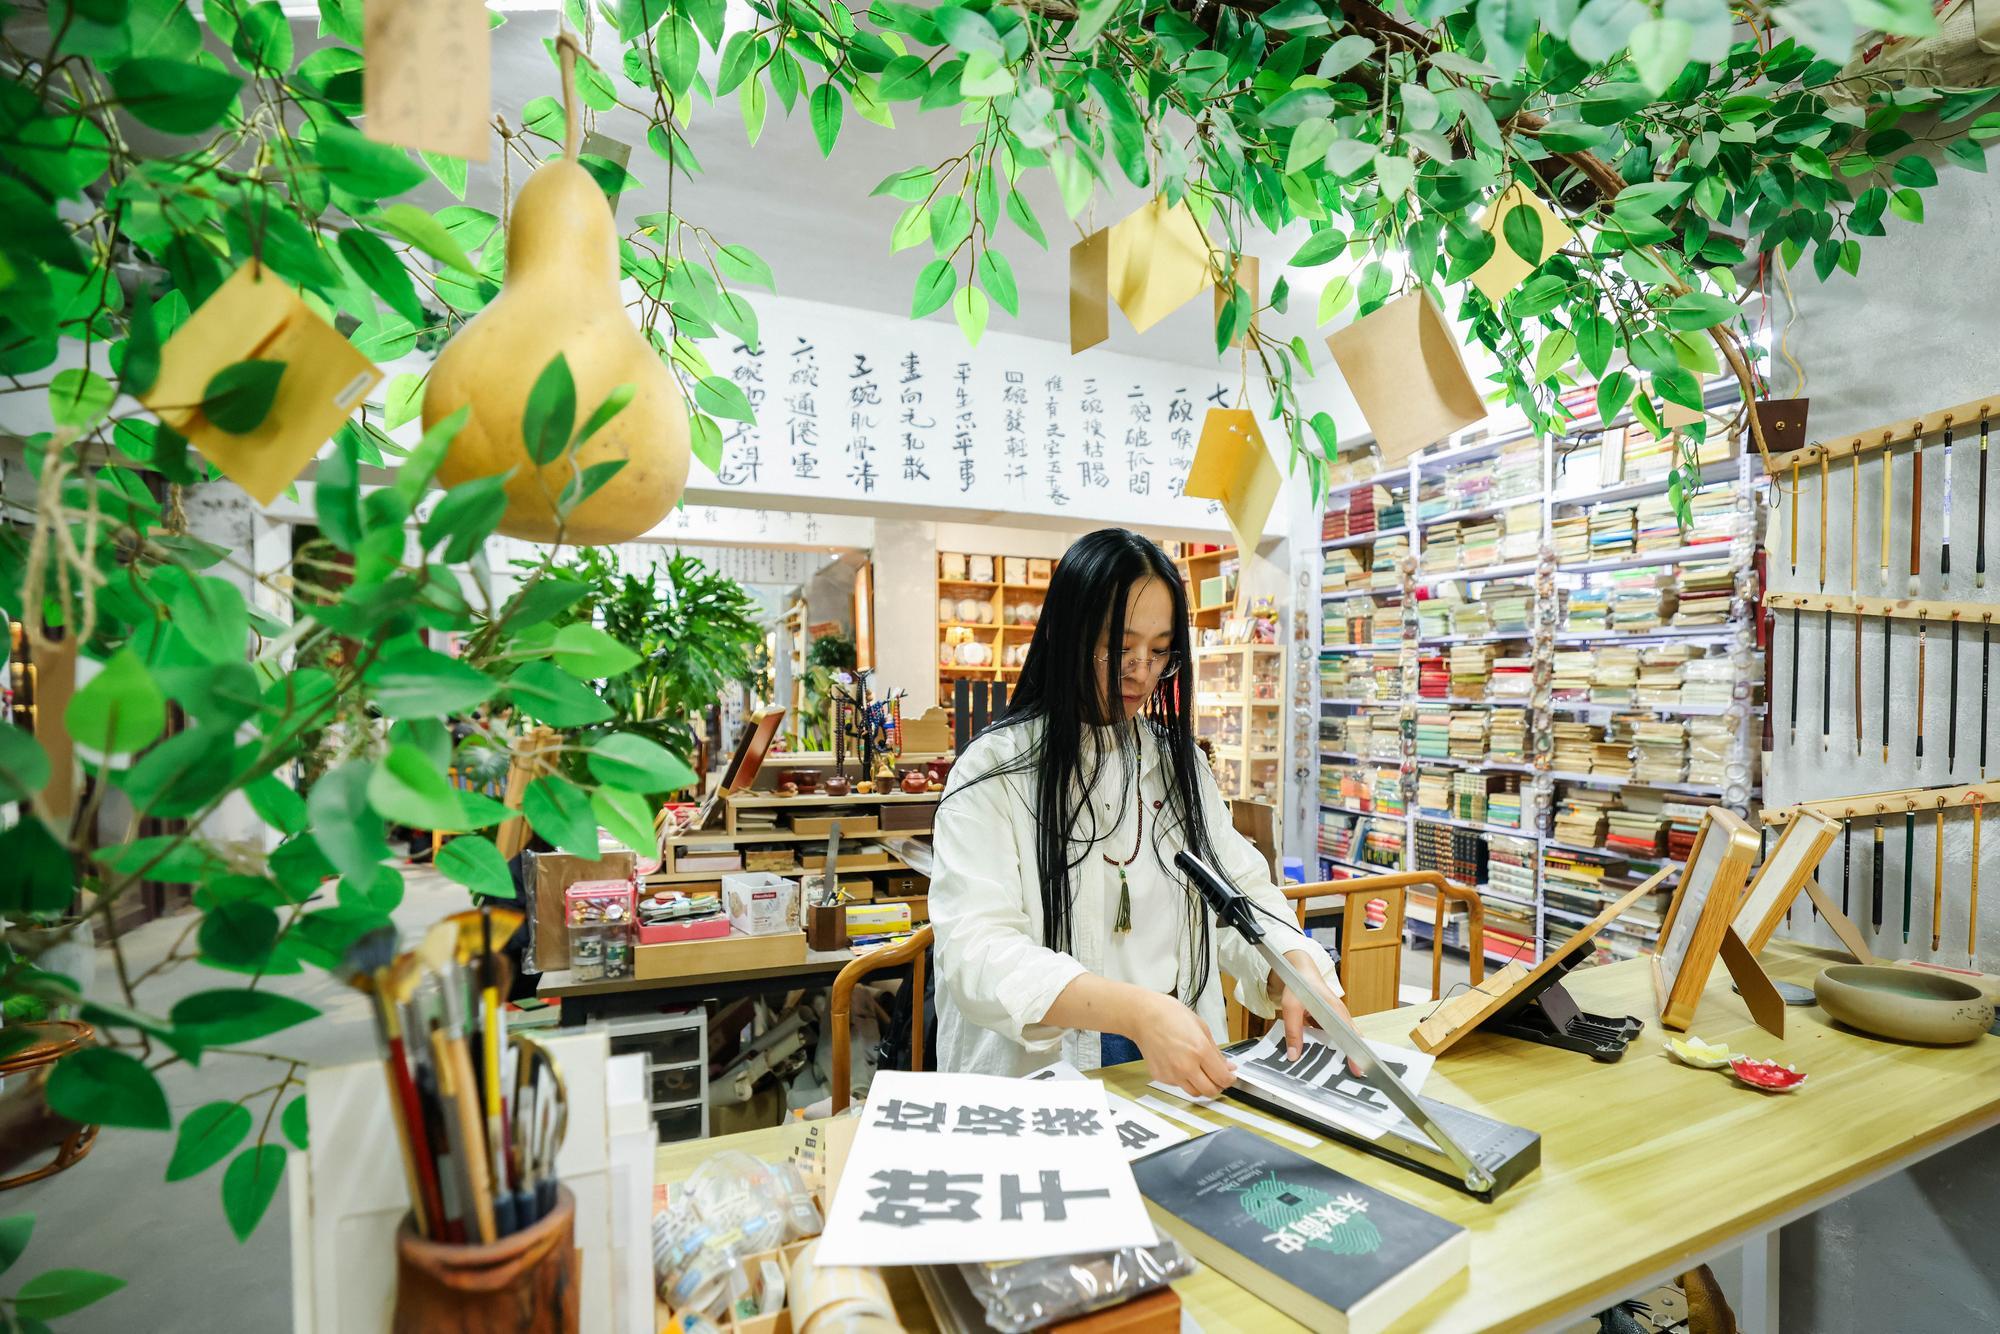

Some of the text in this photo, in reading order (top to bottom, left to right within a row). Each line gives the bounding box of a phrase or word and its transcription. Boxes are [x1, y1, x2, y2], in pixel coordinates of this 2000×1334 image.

[873, 1099, 1104, 1136] 垃圾袋
[858, 1169, 1110, 1228] 饼干
[1262, 1192, 1370, 1255] 未来简史
